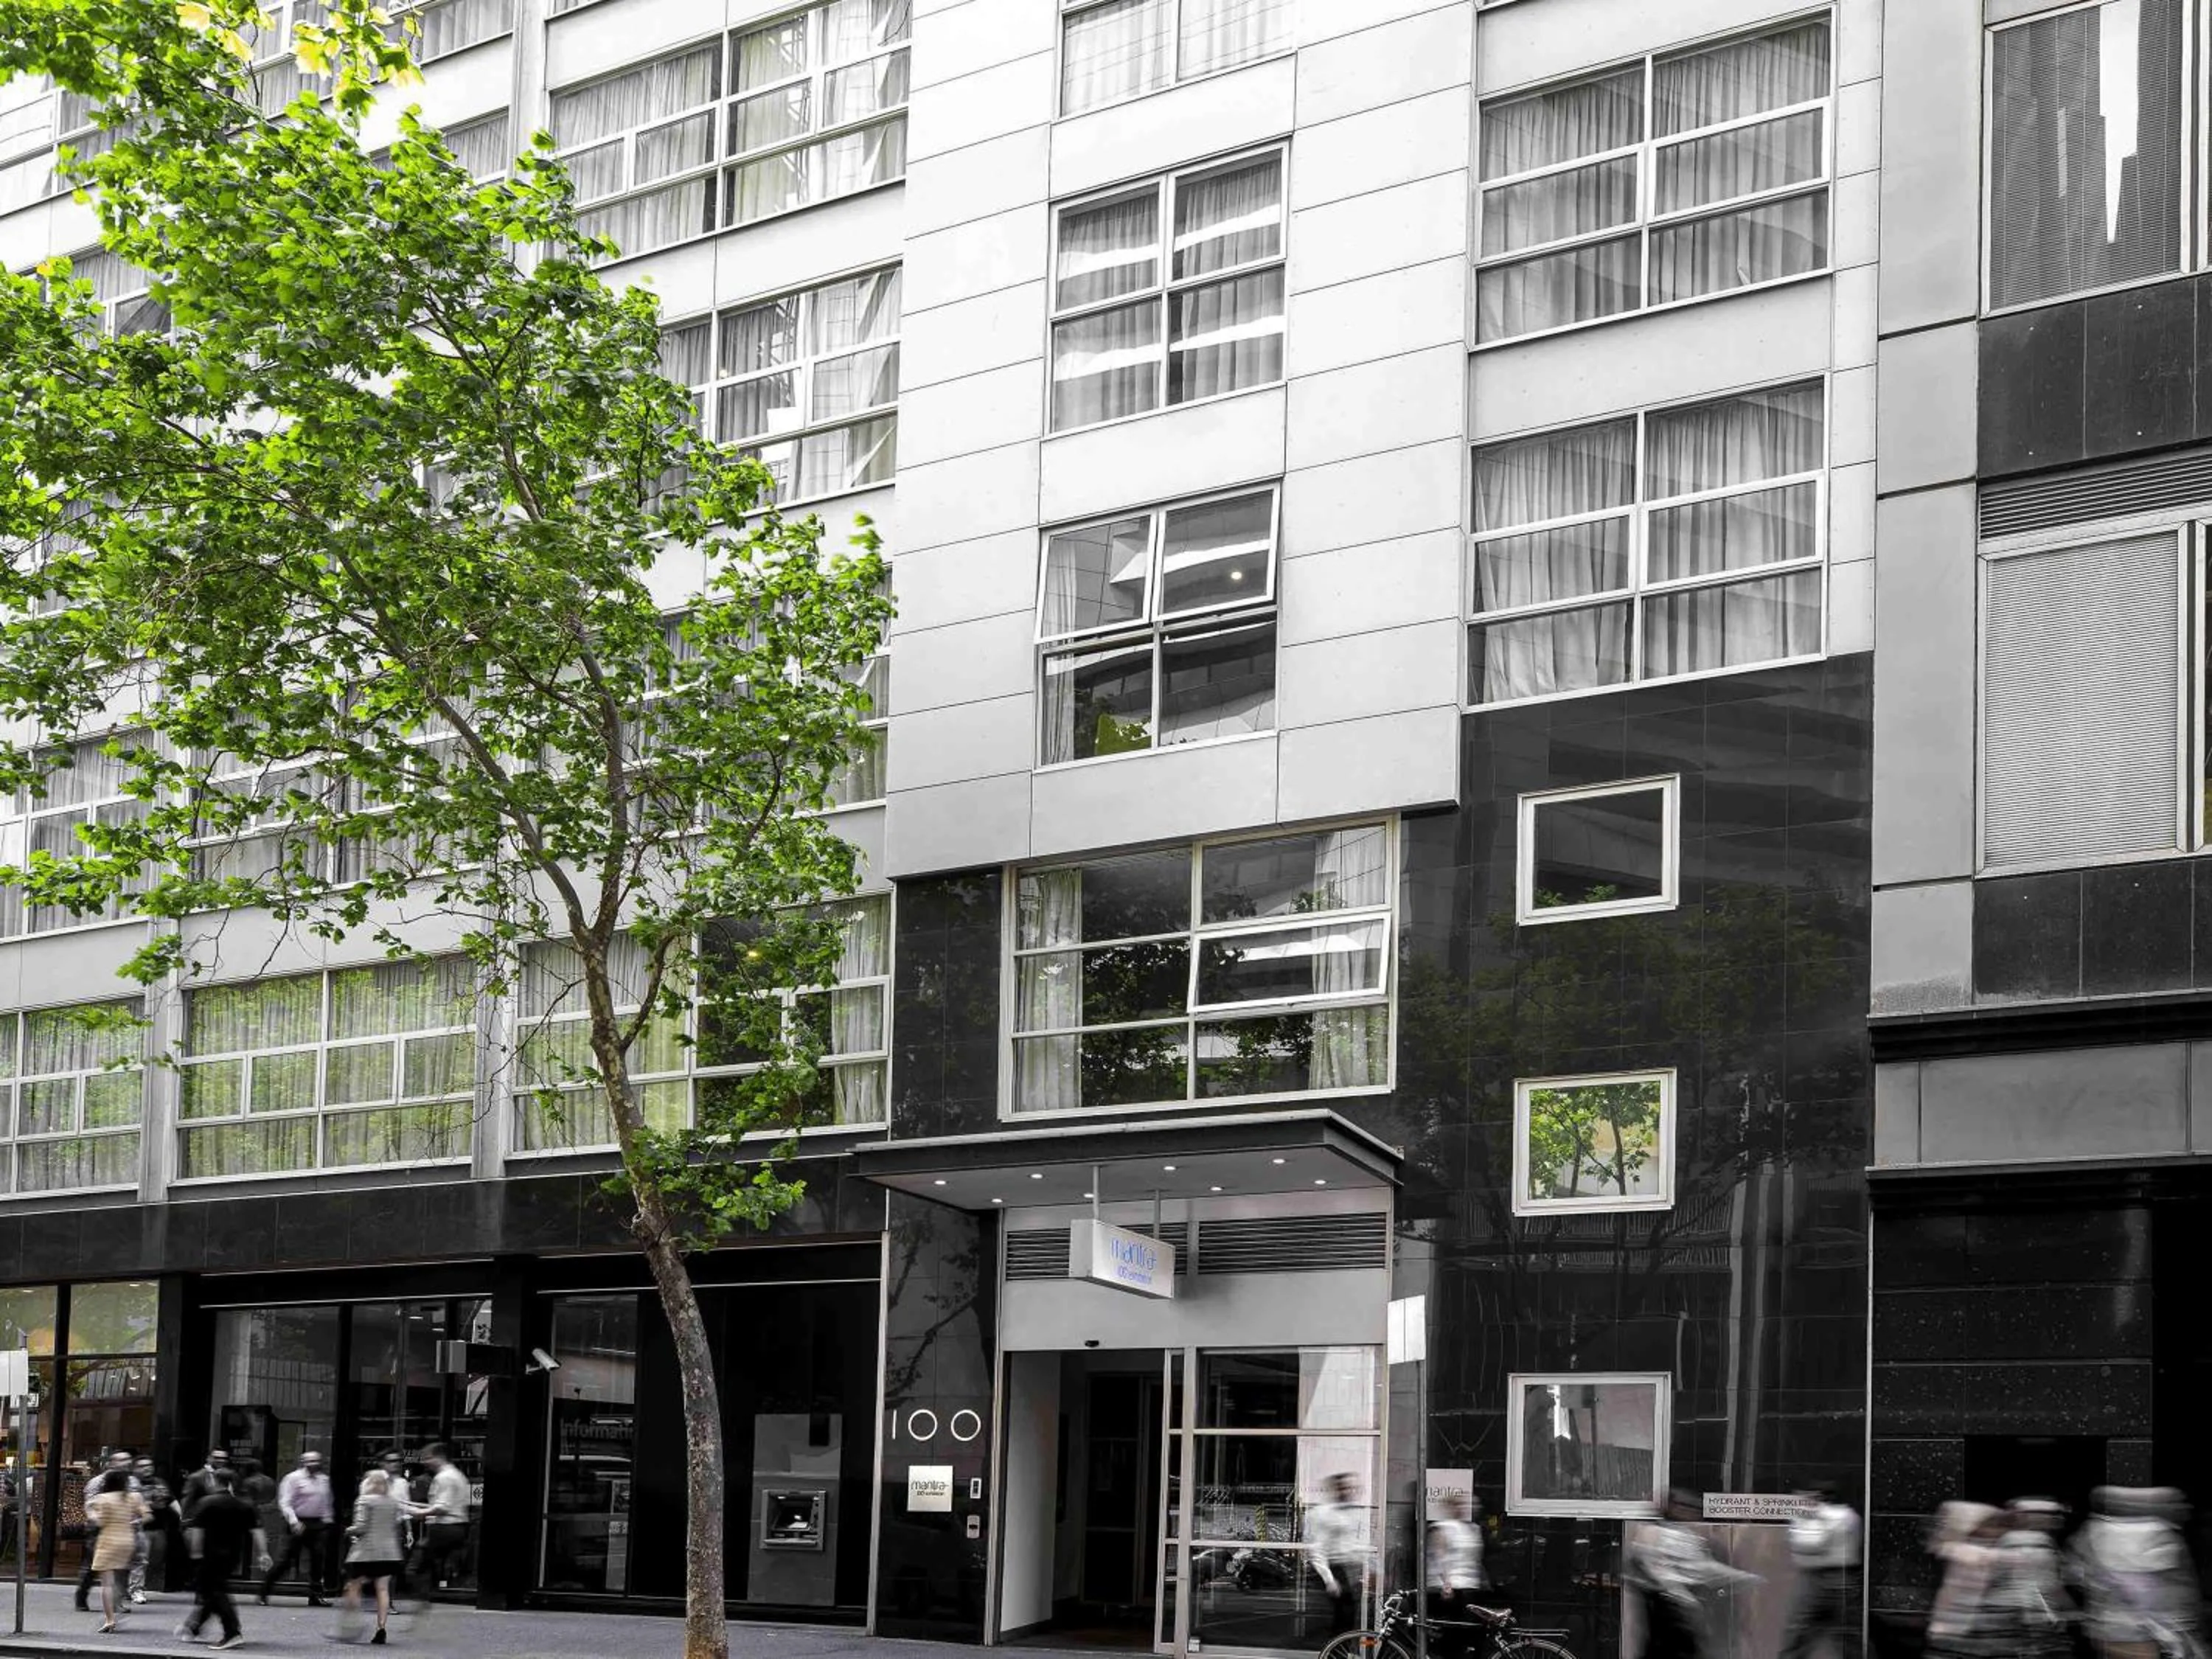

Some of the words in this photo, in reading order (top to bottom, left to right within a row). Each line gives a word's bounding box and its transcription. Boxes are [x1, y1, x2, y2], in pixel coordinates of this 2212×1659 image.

[892, 1409, 981, 1441] 100
[1708, 1498, 1751, 1506] HYDRANT
[1709, 1506, 1750, 1514] BOOSTER
